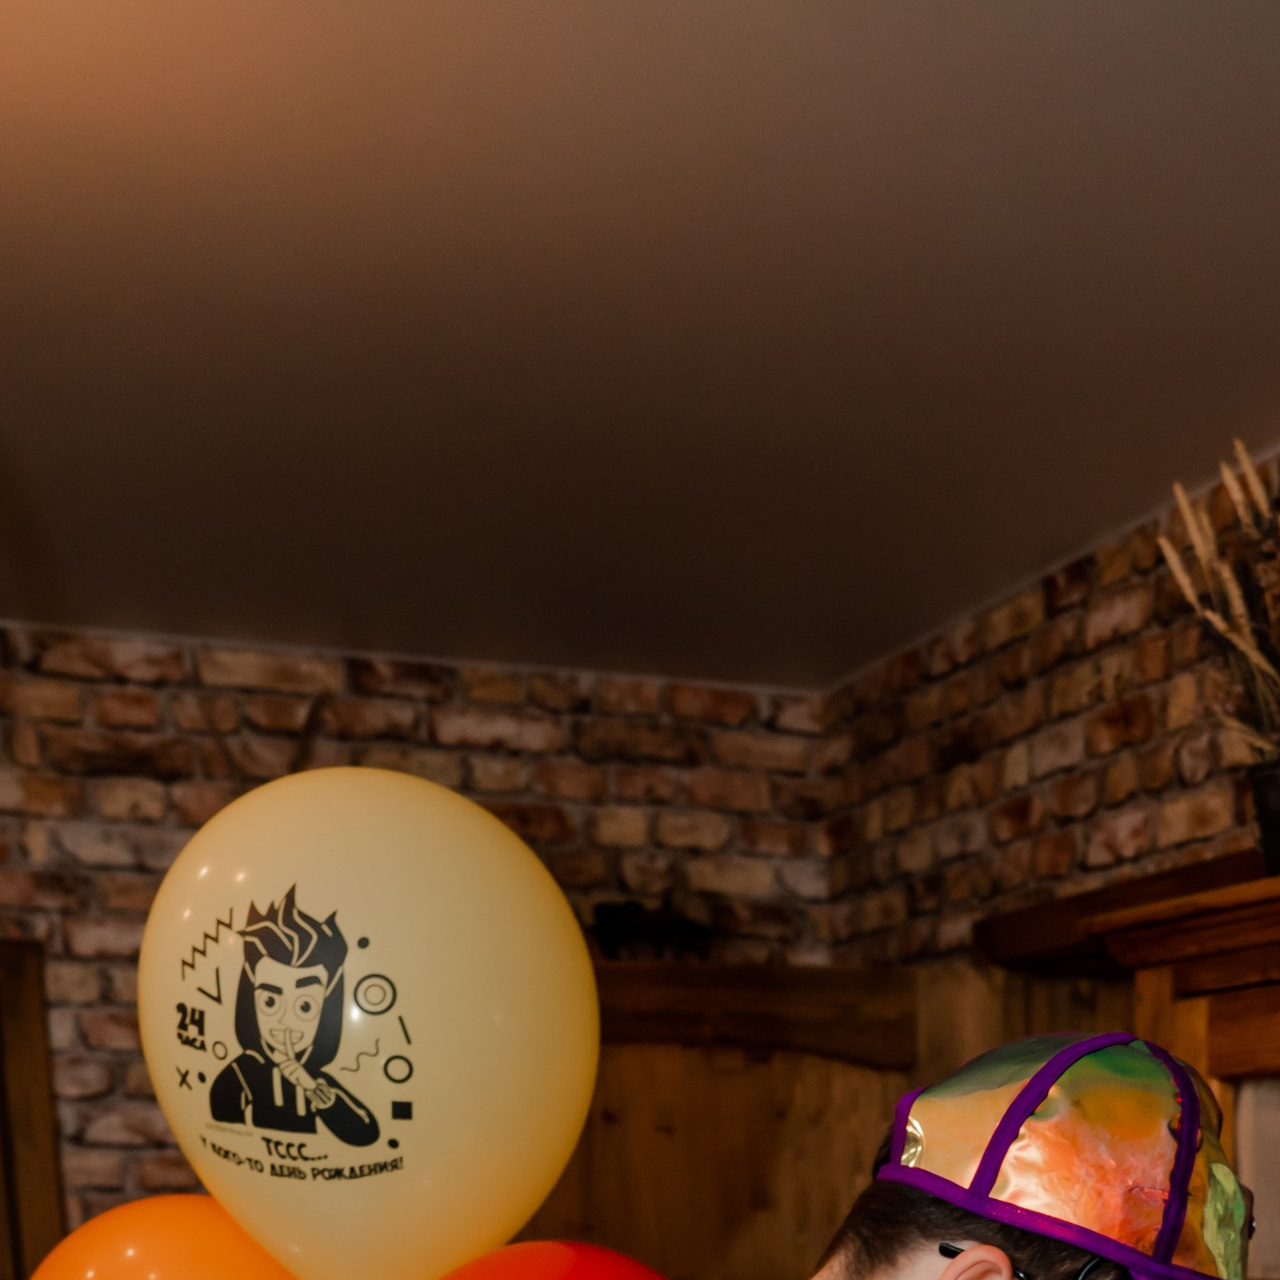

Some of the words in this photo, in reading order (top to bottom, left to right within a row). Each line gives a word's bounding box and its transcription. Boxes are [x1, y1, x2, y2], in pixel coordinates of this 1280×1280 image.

[175, 1002, 205, 1037] 24
[176, 1032, 207, 1052] ЧАСА
[261, 1136, 329, 1162] ТССС...
[270, 1162, 307, 1181] ДЕНЬ
[311, 1156, 404, 1181] РОЖДЕНИЯ!
